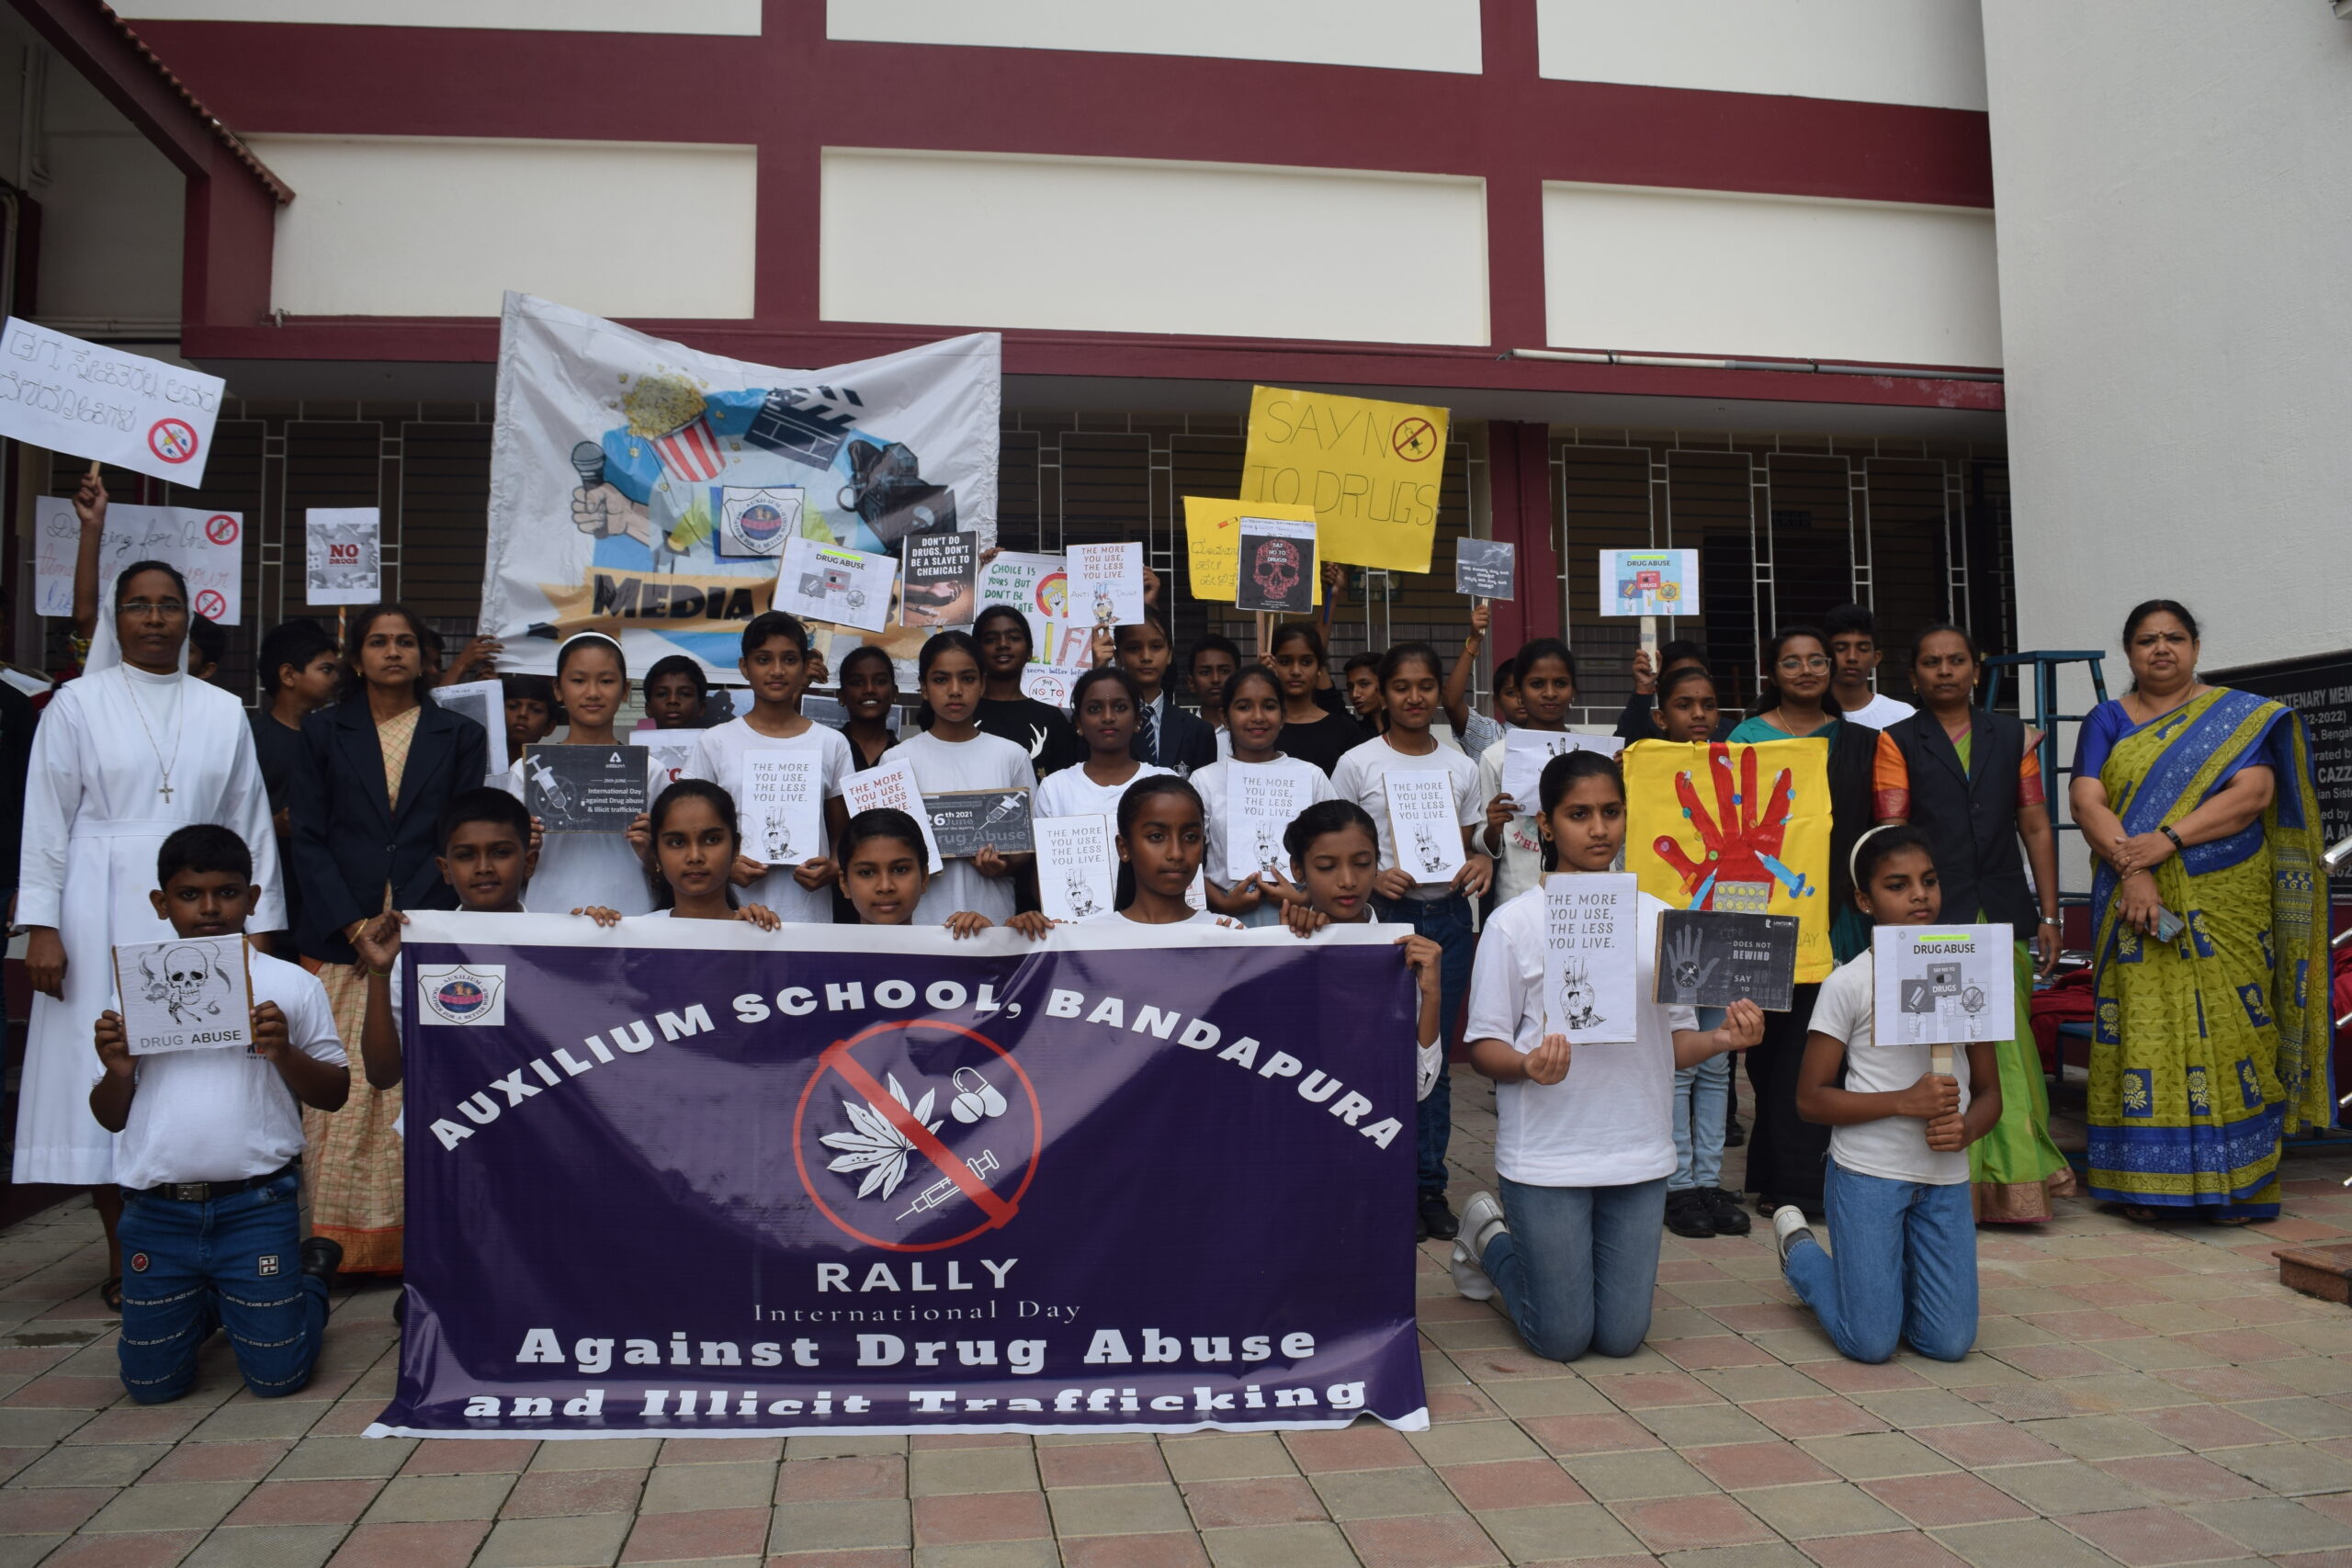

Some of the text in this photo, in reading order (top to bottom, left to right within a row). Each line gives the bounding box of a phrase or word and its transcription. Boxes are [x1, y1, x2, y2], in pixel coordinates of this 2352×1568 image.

[1265, 401, 1361, 450] SAY
[1250, 465, 1435, 525] TO DRUGS
[922, 536, 960, 547] DON'T DO
[330, 544, 359, 558] NO
[912, 546, 969, 558] DRUGS, DON'T
[816, 553, 839, 564] DRUG
[840, 558, 865, 570] ABUSE
[911, 558, 922, 567] BE
[923, 558, 929, 566] A
[932, 557, 956, 565] SLAVE
[917, 566, 963, 576] CHEMICALS
[991, 564, 1036, 576] CHOICE IS
[988, 577, 1031, 588] YOURS BUT
[593, 574, 755, 621] MEDIA
[985, 590, 1023, 600] DON'T BE
[755, 773, 777, 782] YOU
[1243, 777, 1295, 787] THE MORE
[755, 784, 807, 792] THE LESS
[849, 772, 903, 795] THE MORE
[1245, 787, 1265, 795] YOU
[753, 794, 775, 802] YOU
[854, 792, 876, 805] YOU
[882, 792, 907, 807] LESS
[1245, 797, 1293, 807] THE LESS
[1421, 801, 1444, 809] LESS
[1244, 807, 1264, 816] YOU
[1072, 827, 1102, 836] MORE
[937, 830, 1026, 845] rug Abuse
[1077, 845, 1102, 854] LESS
[1052, 857, 1073, 865] YOU
[1547, 894, 1617, 905] THE MORE
[1550, 908, 1614, 920] YOU USE,
[1550, 922, 1613, 934] THE LESS
[1549, 937, 1615, 949] YOU LIVE.
[1913, 943, 1975, 954] DRUG ABUSE
[1733, 950, 1770, 961] REWIND
[1734, 975, 1751, 983] SAY
[1932, 985, 1956, 993] DRUGS
[141, 1035, 184, 1048] DRUG
[191, 1030, 242, 1043] ABUSE
[429, 979, 1403, 1152] AUXILIUM SCHOOL, BANDAPURA
[816, 1258, 1018, 1293] RALLY
[754, 1300, 1080, 1325] International Day
[515, 1327, 1316, 1374] Against Drug Abuse
[463, 1381, 1366, 1417] and Illicit Trafficking
